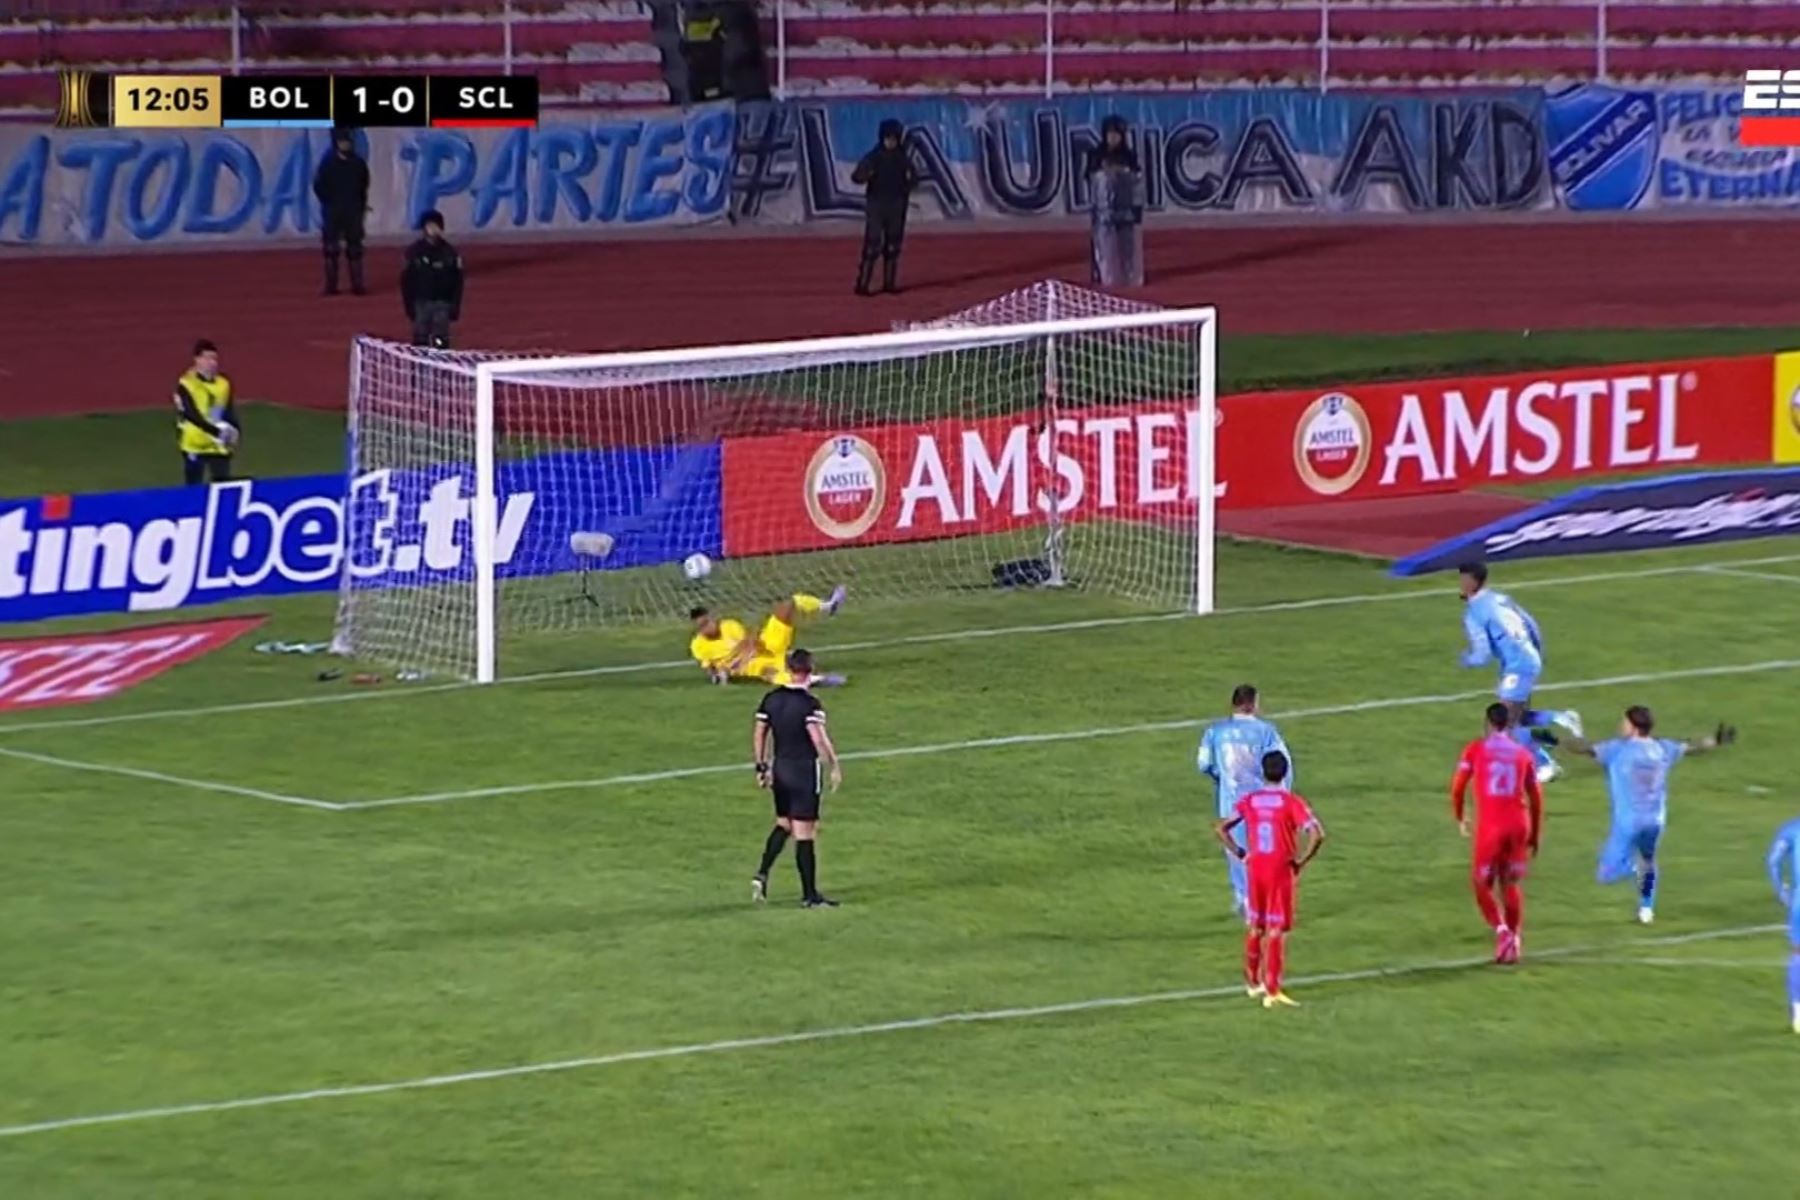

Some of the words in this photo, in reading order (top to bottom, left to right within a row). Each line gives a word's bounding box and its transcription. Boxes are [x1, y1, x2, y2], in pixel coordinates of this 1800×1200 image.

[57, 128, 370, 241] TODA
[400, 104, 734, 231] PARTES
[1329, 103, 1543, 213] AKD
[1309, 427, 1355, 446] AMSTEL
[820, 472, 870, 491] AMSTEL
